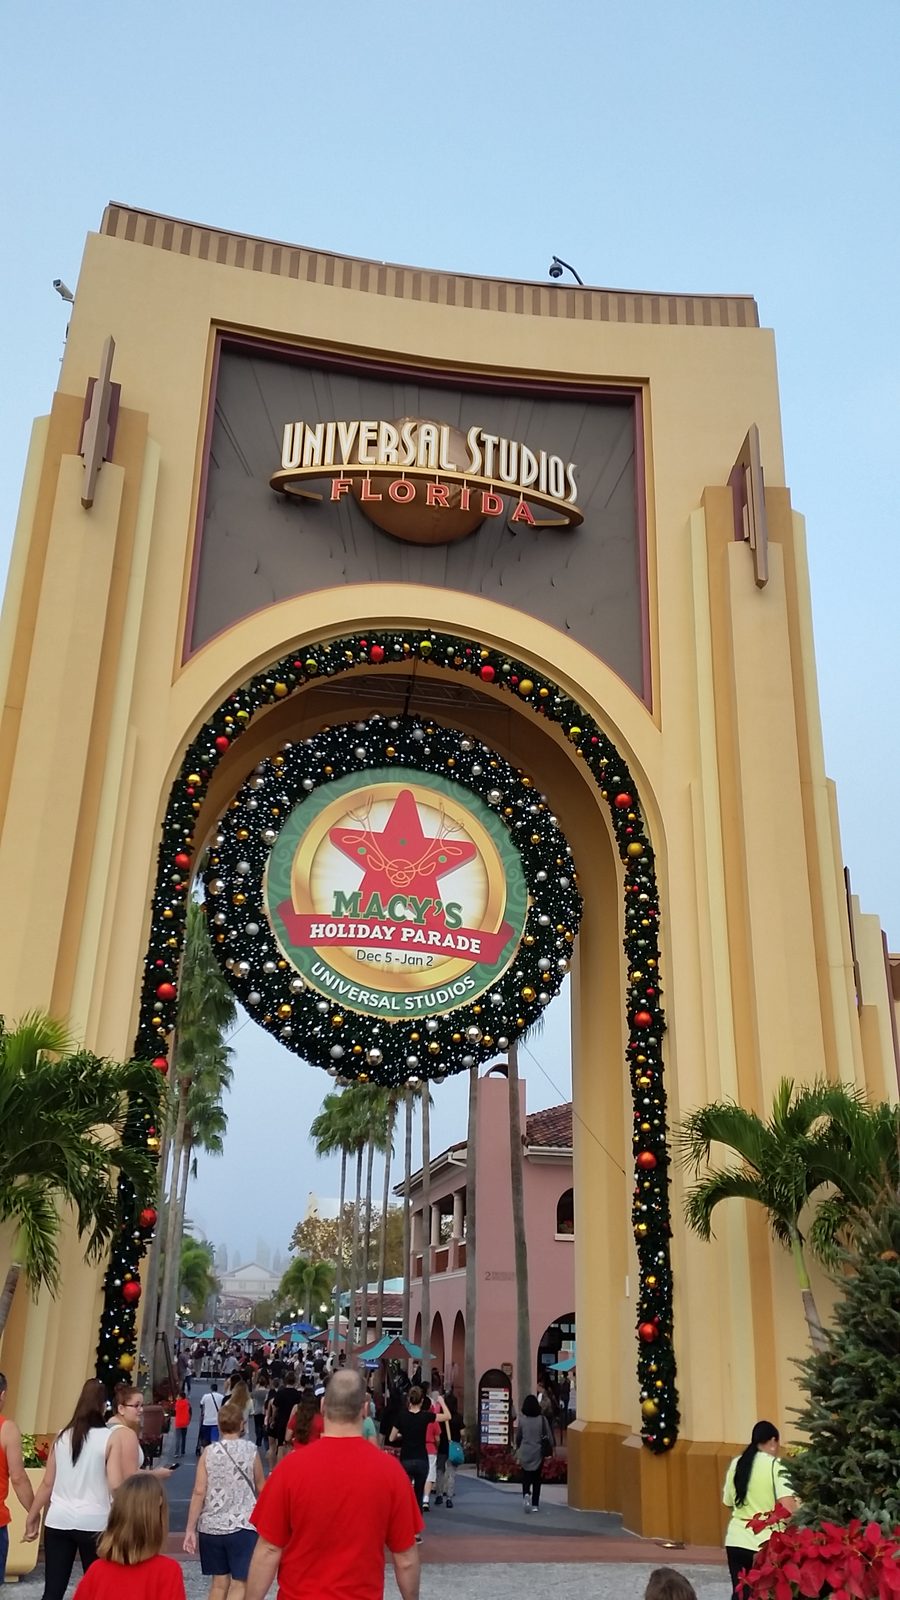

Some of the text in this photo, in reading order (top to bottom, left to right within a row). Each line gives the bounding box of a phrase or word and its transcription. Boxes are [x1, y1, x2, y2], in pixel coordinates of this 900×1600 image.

[281, 421, 578, 504] UNIVERSAL STUDIOS
[330, 478, 536, 525] FLORIDA
[331, 890, 463, 929] MACY'S
[308, 923, 482, 954] HOLIDAY PARADE
[356, 949, 381, 963] Dec
[384, 952, 393, 964] 5
[425, 955, 434, 967] 2
[310, 961, 476, 1010] UNIVERSAL STUDIOS
